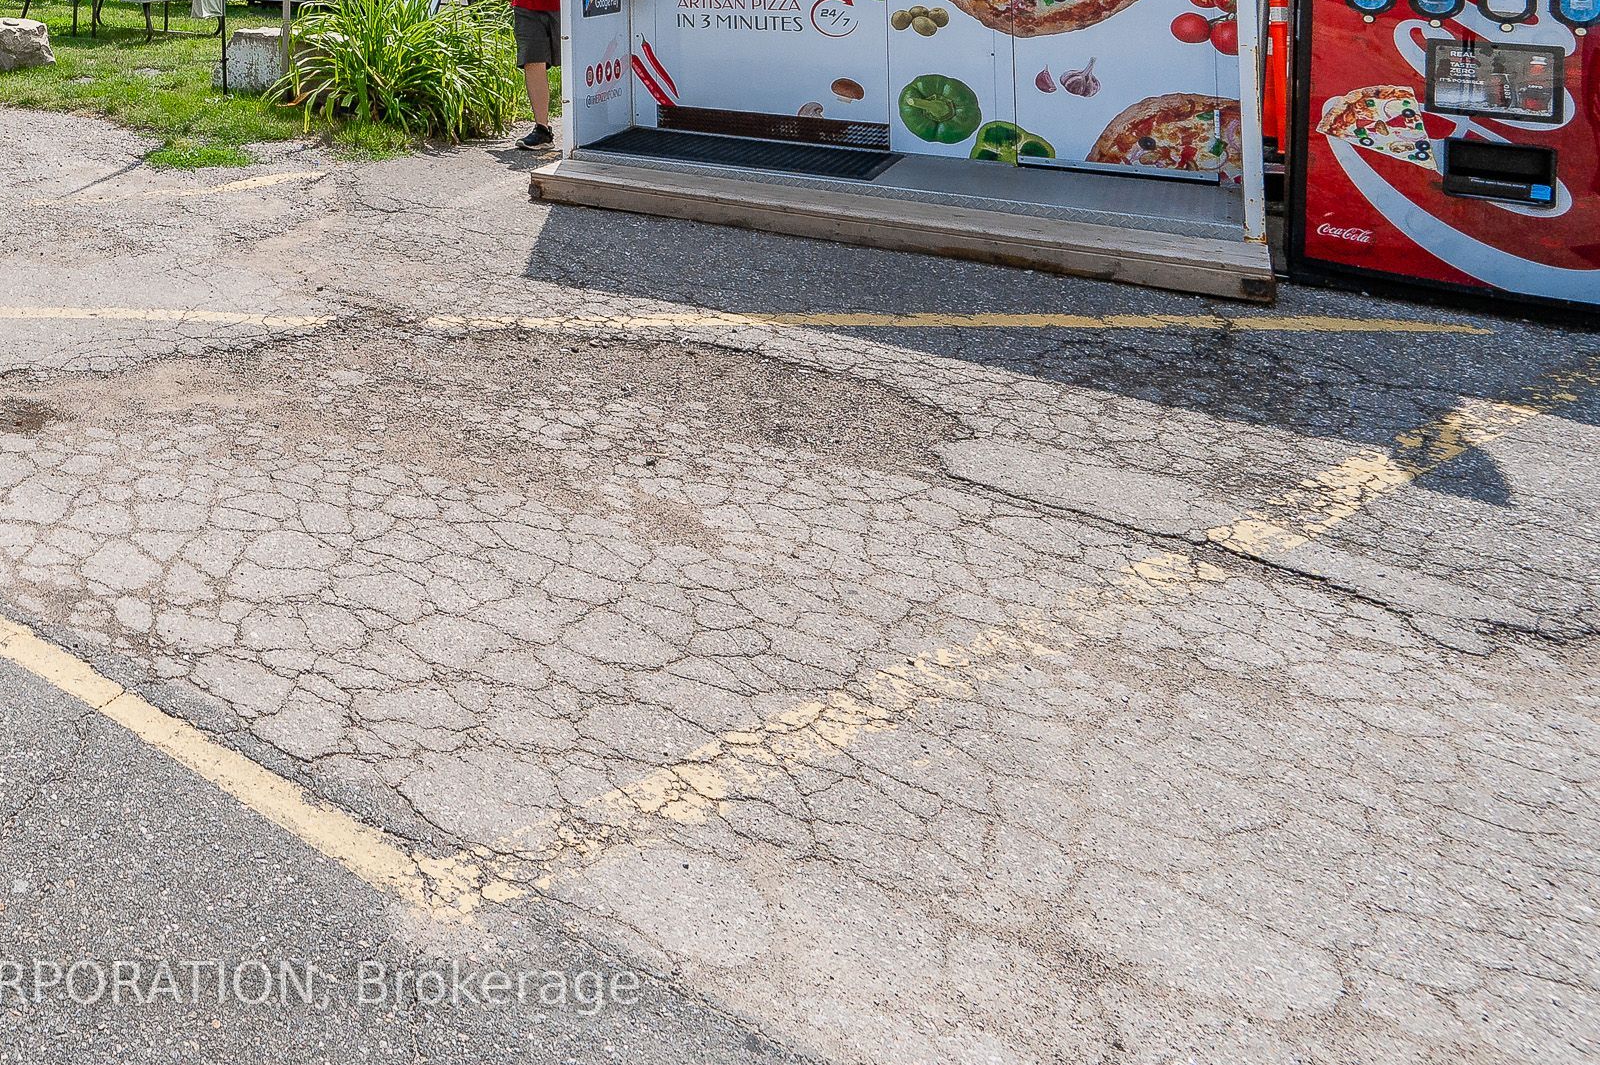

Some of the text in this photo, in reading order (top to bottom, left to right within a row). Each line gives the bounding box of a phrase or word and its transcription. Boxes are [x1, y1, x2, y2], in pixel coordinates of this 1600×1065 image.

[676, 13, 803, 32] IN 3 MINUTES
[820, 8, 851, 27] 24/7
